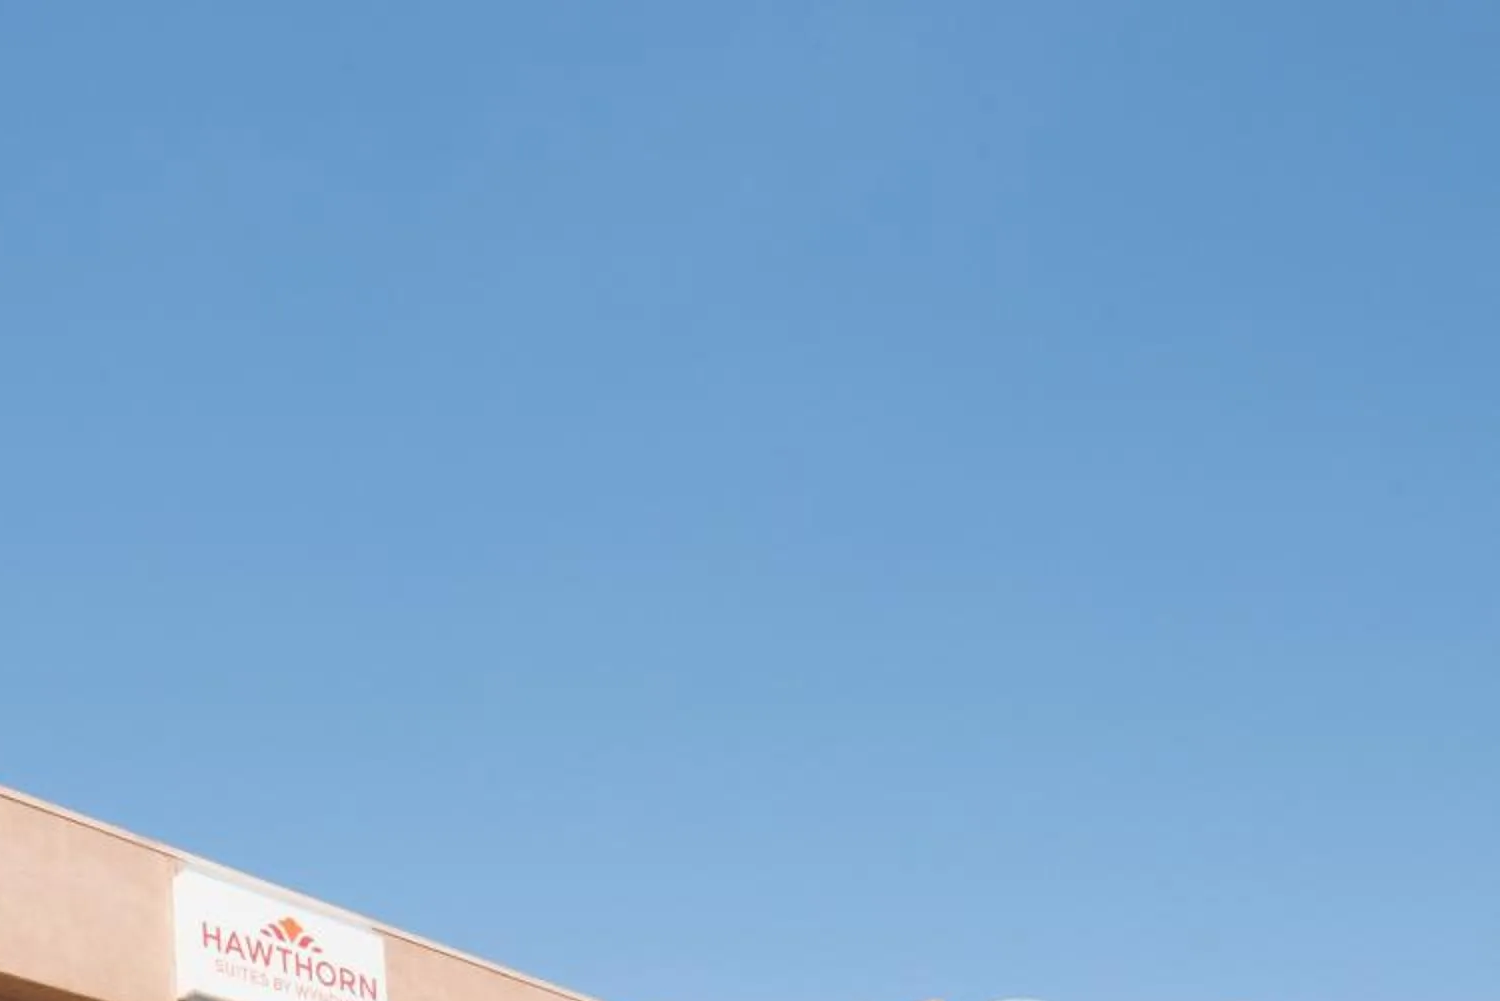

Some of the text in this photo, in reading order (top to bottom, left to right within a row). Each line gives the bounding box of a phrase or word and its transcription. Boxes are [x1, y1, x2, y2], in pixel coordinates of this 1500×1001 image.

[202, 921, 378, 1001] HAWTHORN
[214, 958, 269, 987] SUITES
[273, 977, 291, 993] BY
